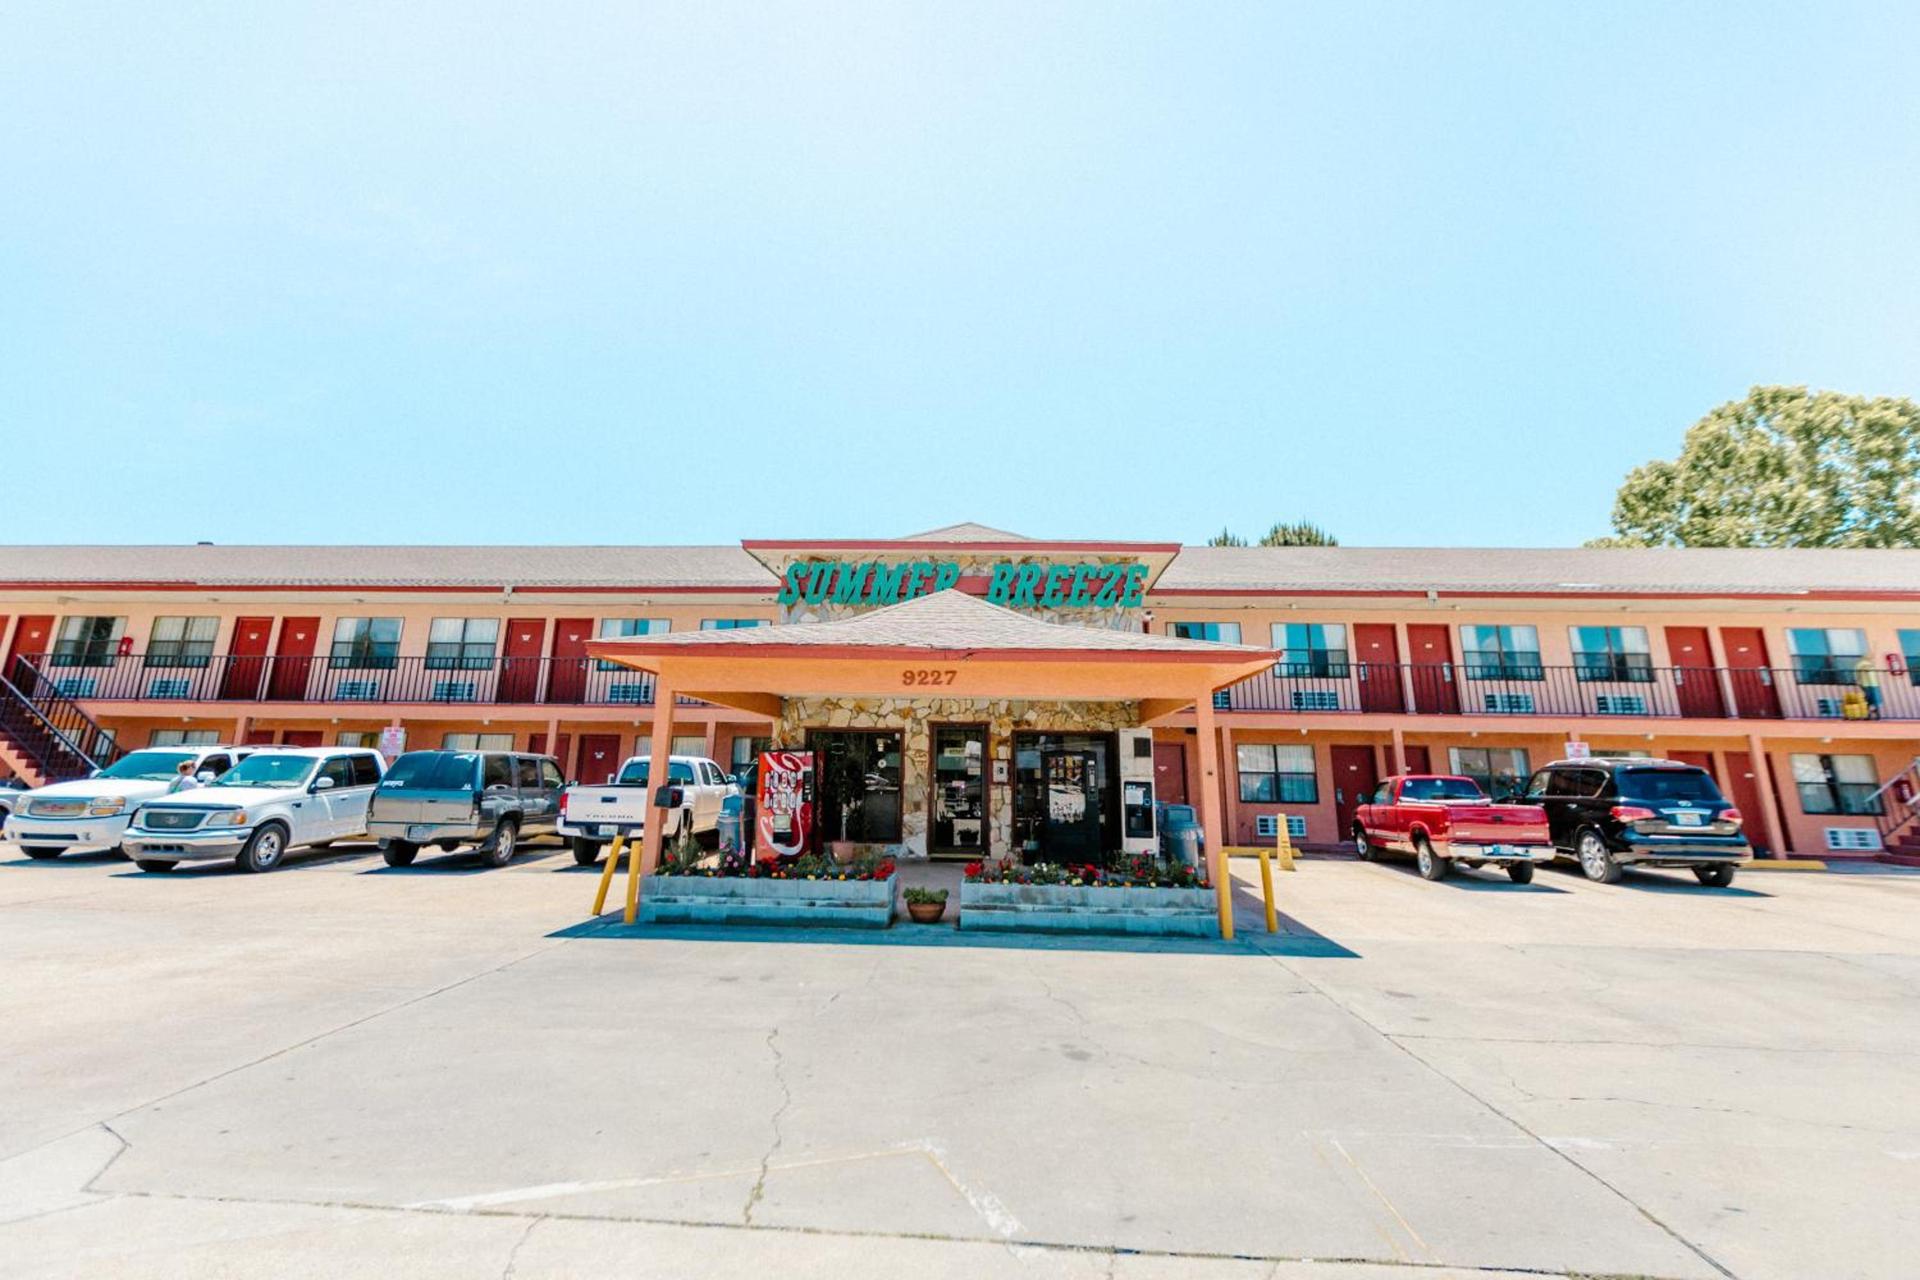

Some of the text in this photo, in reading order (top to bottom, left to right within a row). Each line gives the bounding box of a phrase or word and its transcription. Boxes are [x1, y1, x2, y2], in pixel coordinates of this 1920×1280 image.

[778, 560, 1149, 608] SUMMER BREEZE
[902, 669, 958, 686] 9227
